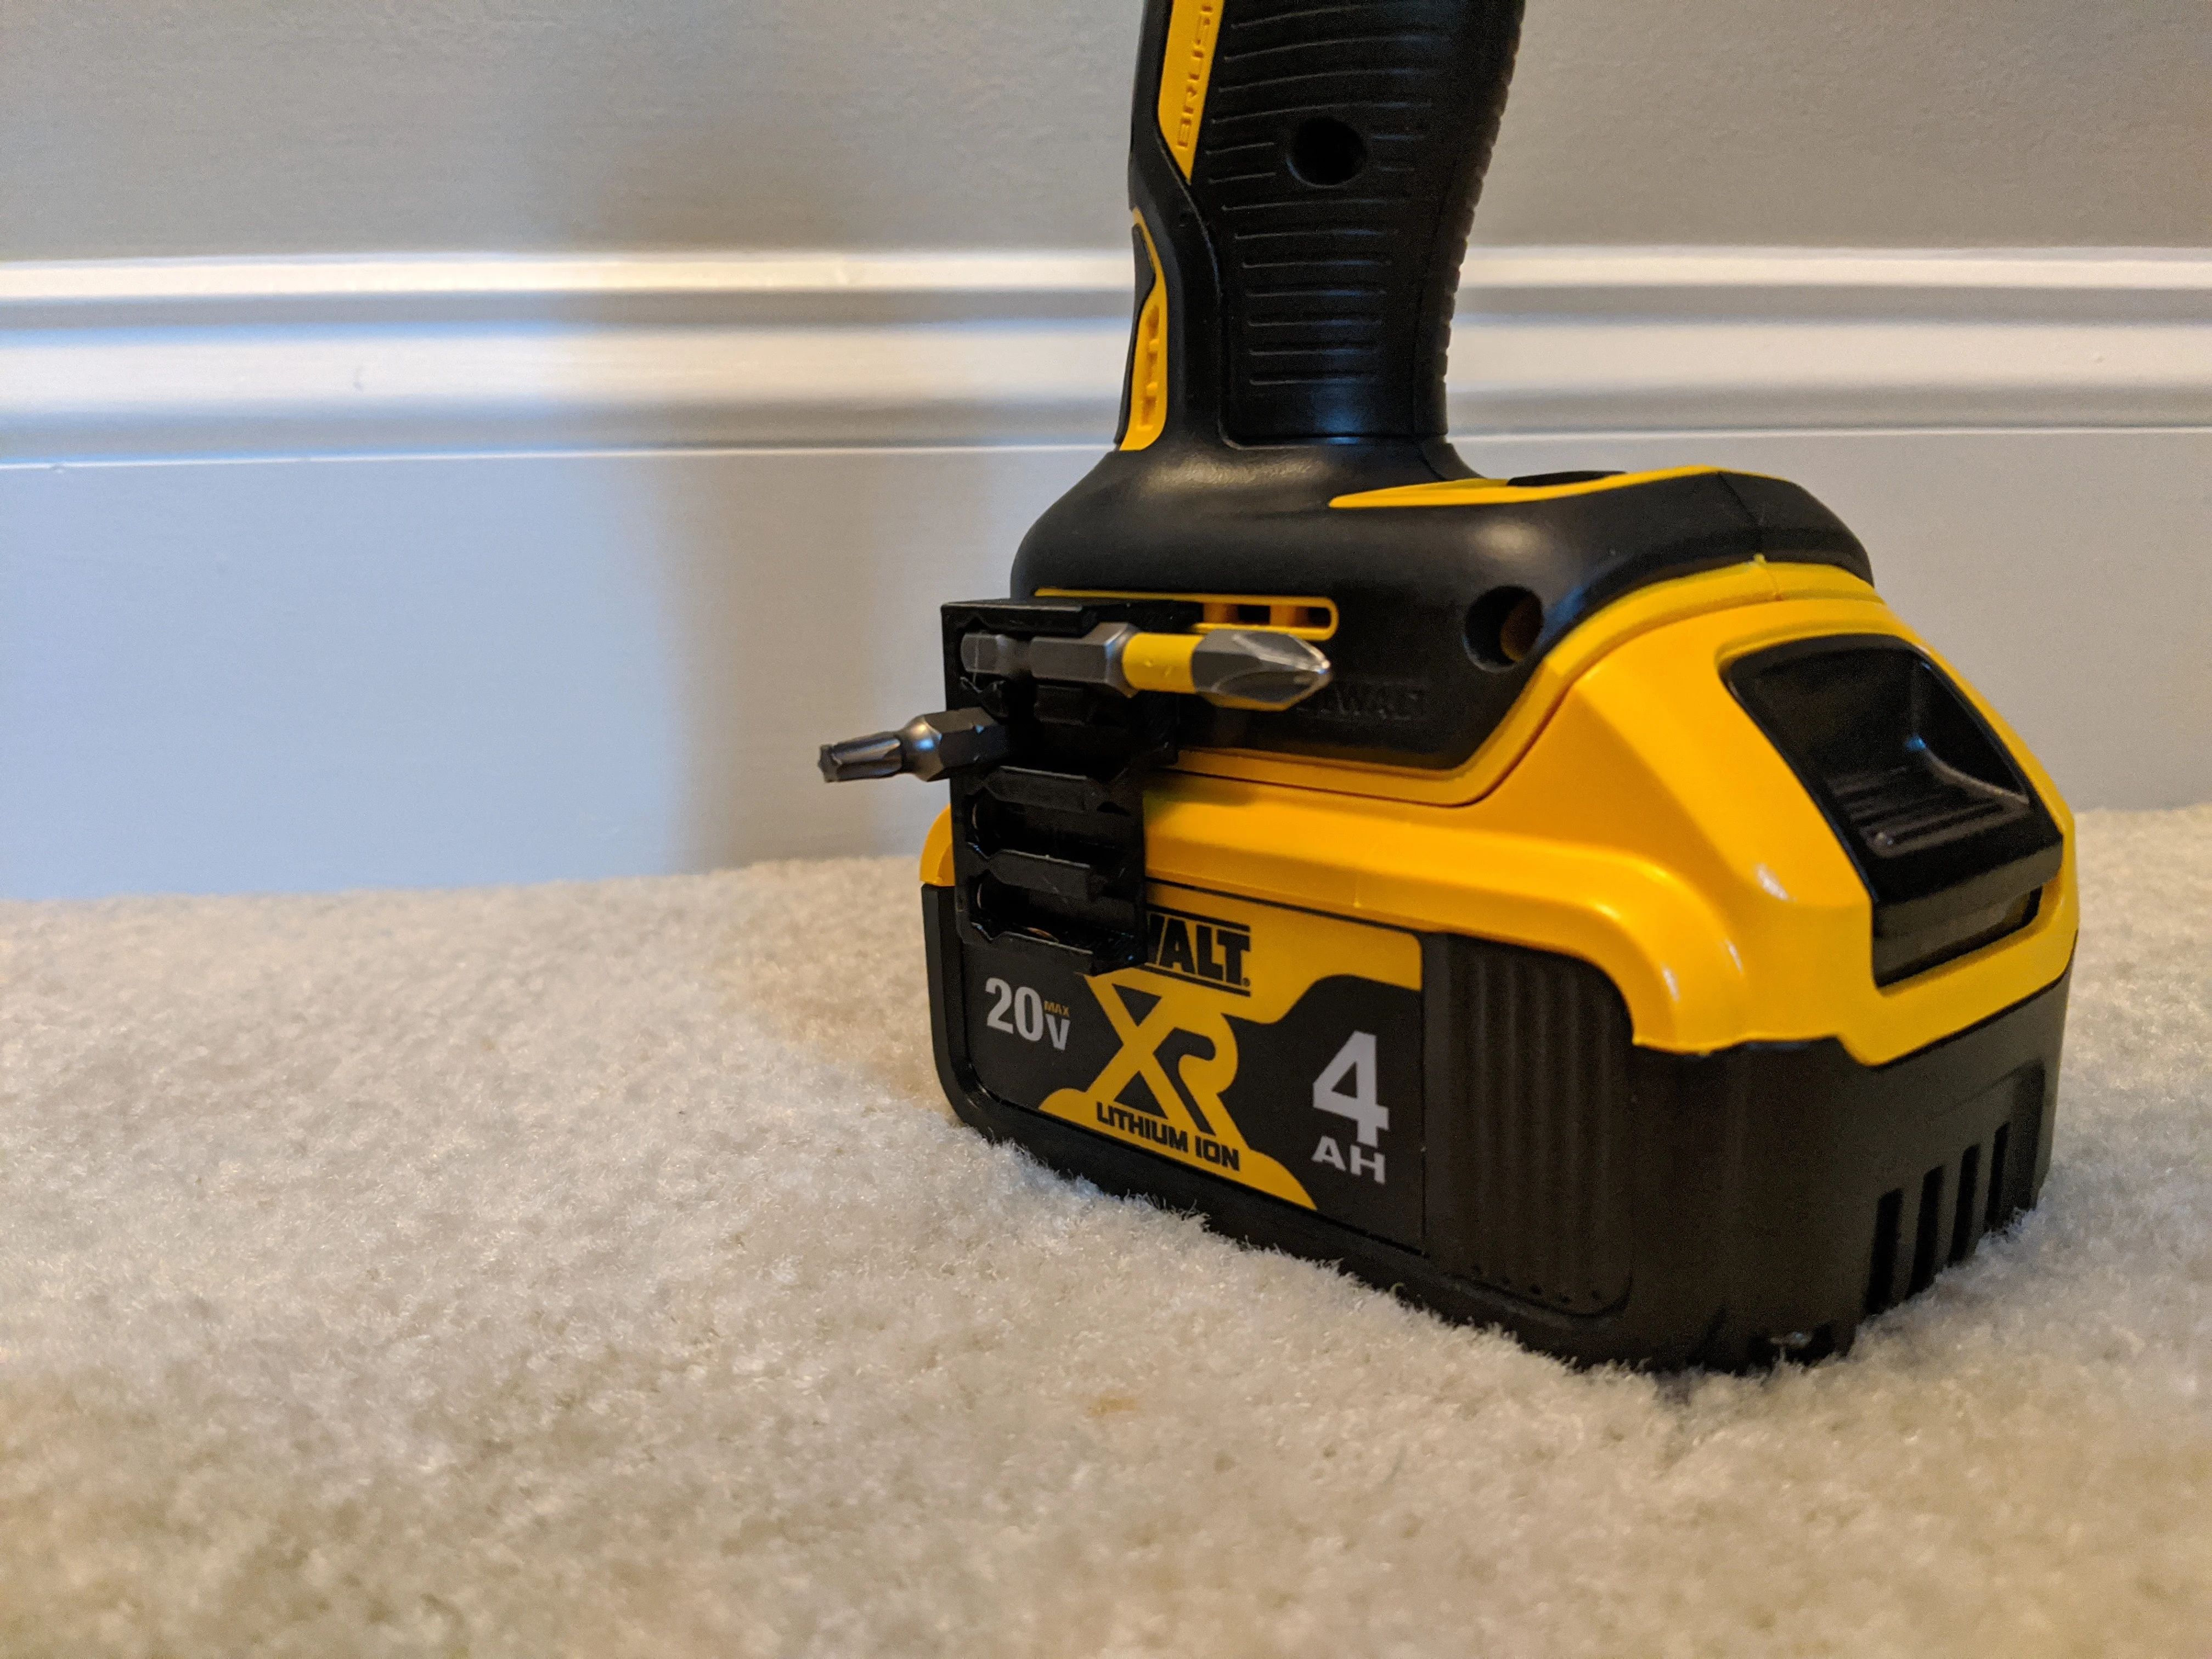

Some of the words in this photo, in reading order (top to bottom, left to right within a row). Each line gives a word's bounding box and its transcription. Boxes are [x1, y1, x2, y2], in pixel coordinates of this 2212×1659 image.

[1044, 1001, 1070, 1018] MAX
[1085, 970, 1243, 1138] XR
[1313, 1031, 1389, 1147] 4
[1097, 1102, 1189, 1154] LITHIUM
[1195, 1138, 1240, 1171] ION
[1312, 1136, 1385, 1184] AH
